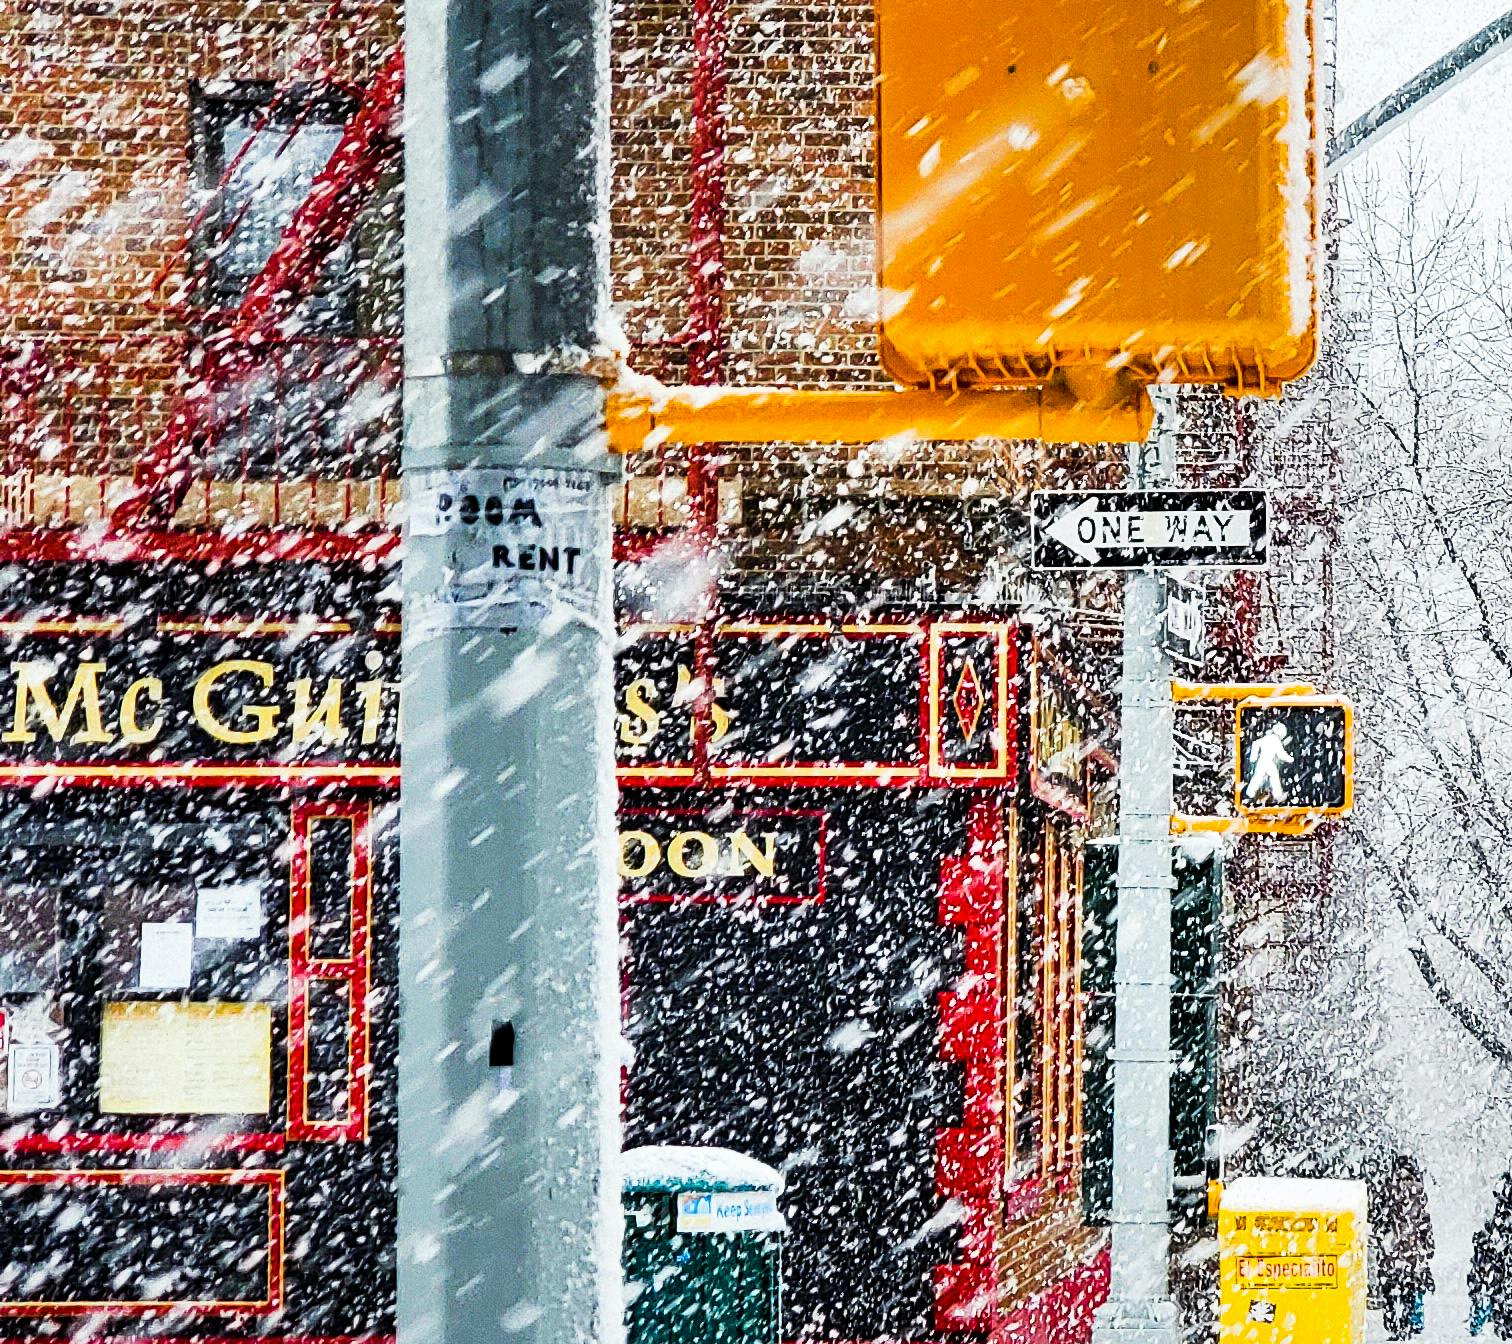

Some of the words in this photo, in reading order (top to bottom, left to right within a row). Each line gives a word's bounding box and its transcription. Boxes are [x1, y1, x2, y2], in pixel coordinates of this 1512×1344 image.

[1077, 516, 1144, 543] ONE
[1165, 514, 1234, 542] WAY
[492, 543, 581, 575] RENT
[618, 829, 777, 878] OON
[1257, 1258, 1335, 1277] Especiaito
